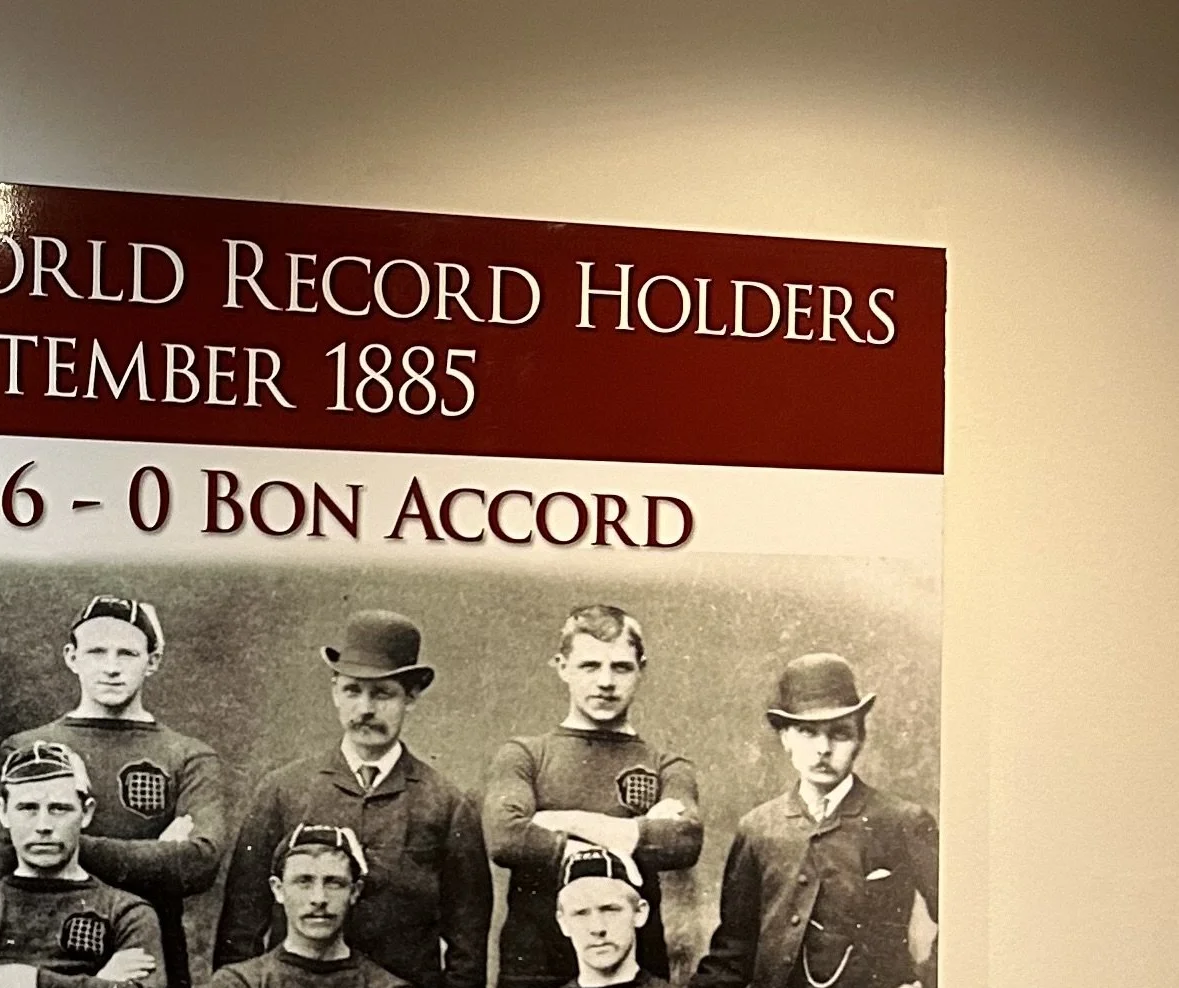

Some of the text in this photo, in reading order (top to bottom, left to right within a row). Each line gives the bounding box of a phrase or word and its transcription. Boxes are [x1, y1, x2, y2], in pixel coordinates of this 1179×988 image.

[222, 238, 541, 325] RECORD
[575, 261, 896, 345] HOLDERS
[325, 341, 477, 417] 1885
[129, 466, 170, 533] 0
[200, 469, 363, 539] BON
[384, 476, 694, 549] ACCORD
